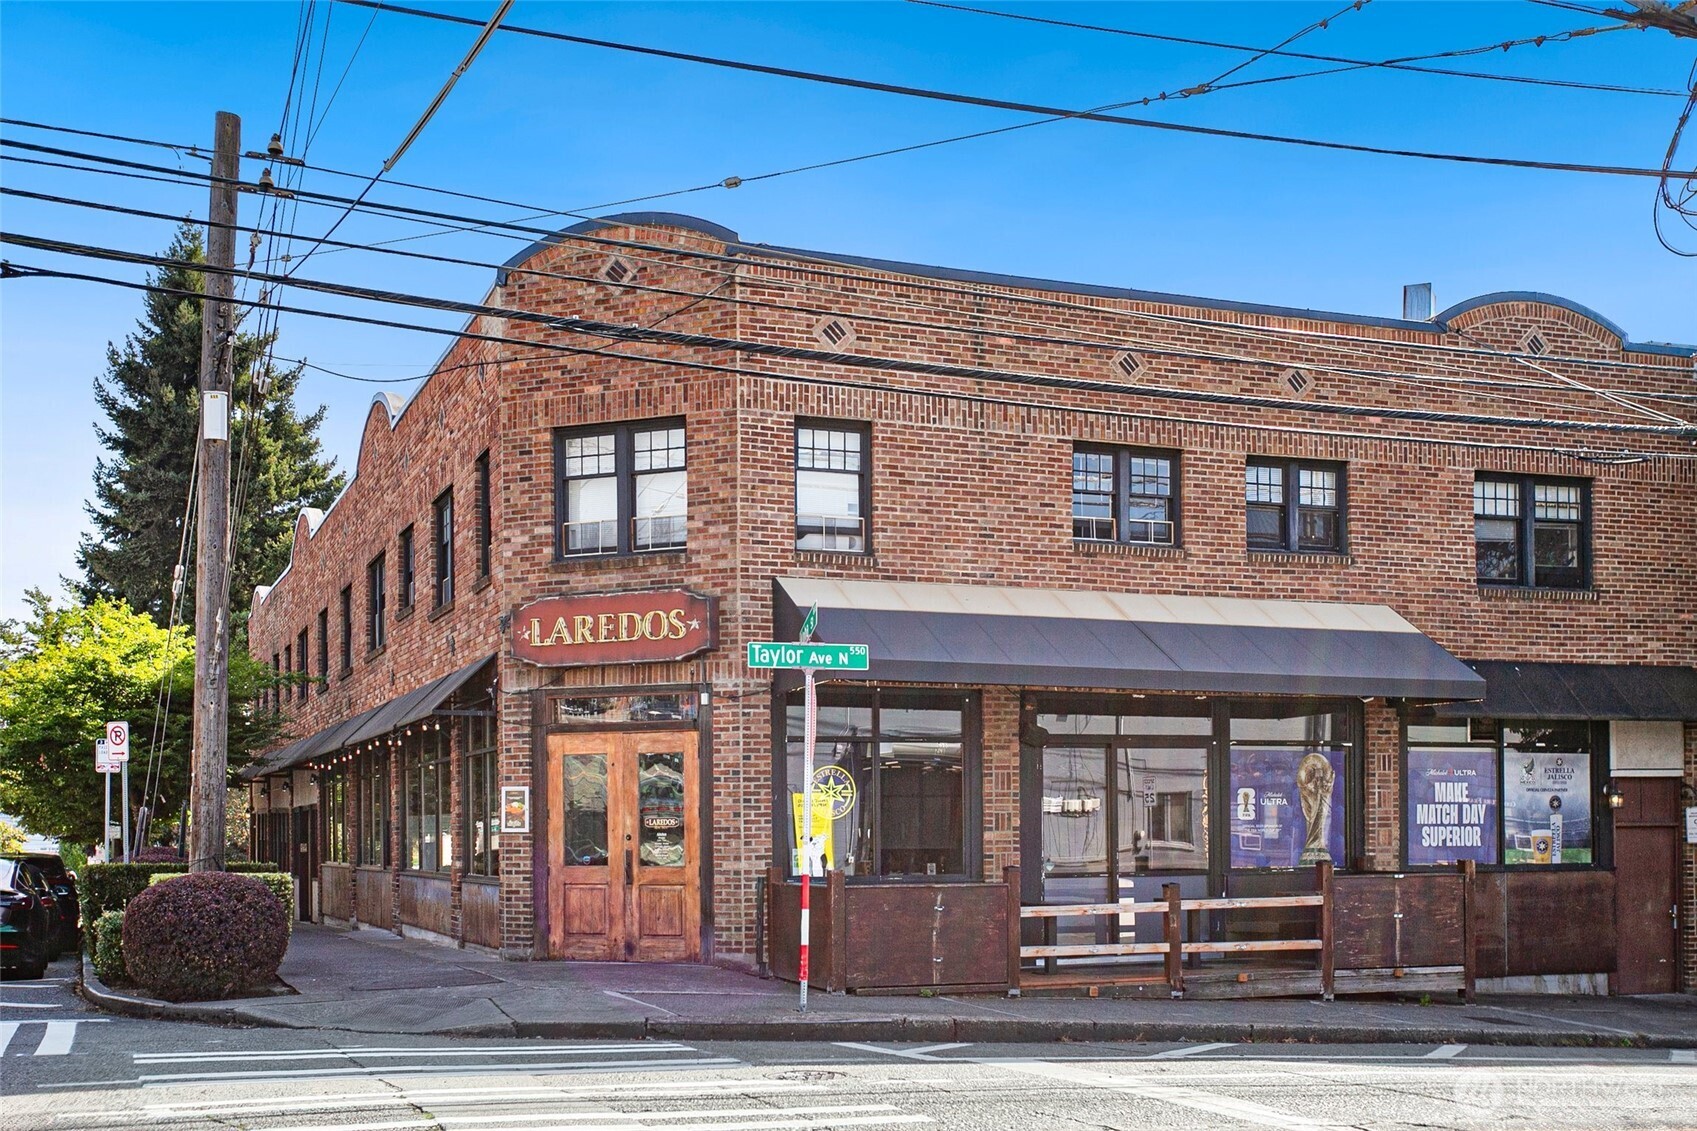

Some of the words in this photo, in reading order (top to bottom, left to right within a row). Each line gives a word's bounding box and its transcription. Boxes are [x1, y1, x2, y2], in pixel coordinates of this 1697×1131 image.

[530, 609, 686, 646] LAREDOS
[751, 644, 804, 667] Taylor
[809, 652, 832, 664] Ave
[838, 652, 849, 665] N
[849, 646, 866, 655] 550
[1260, 798, 1288, 806] ULTRA
[1434, 782, 1469, 803] MAKE
[648, 818, 676, 826] LAREDOS
[1416, 804, 1459, 824] MATCH
[1462, 804, 1486, 824] DAY
[1421, 826, 1482, 847] SUPERIOR
